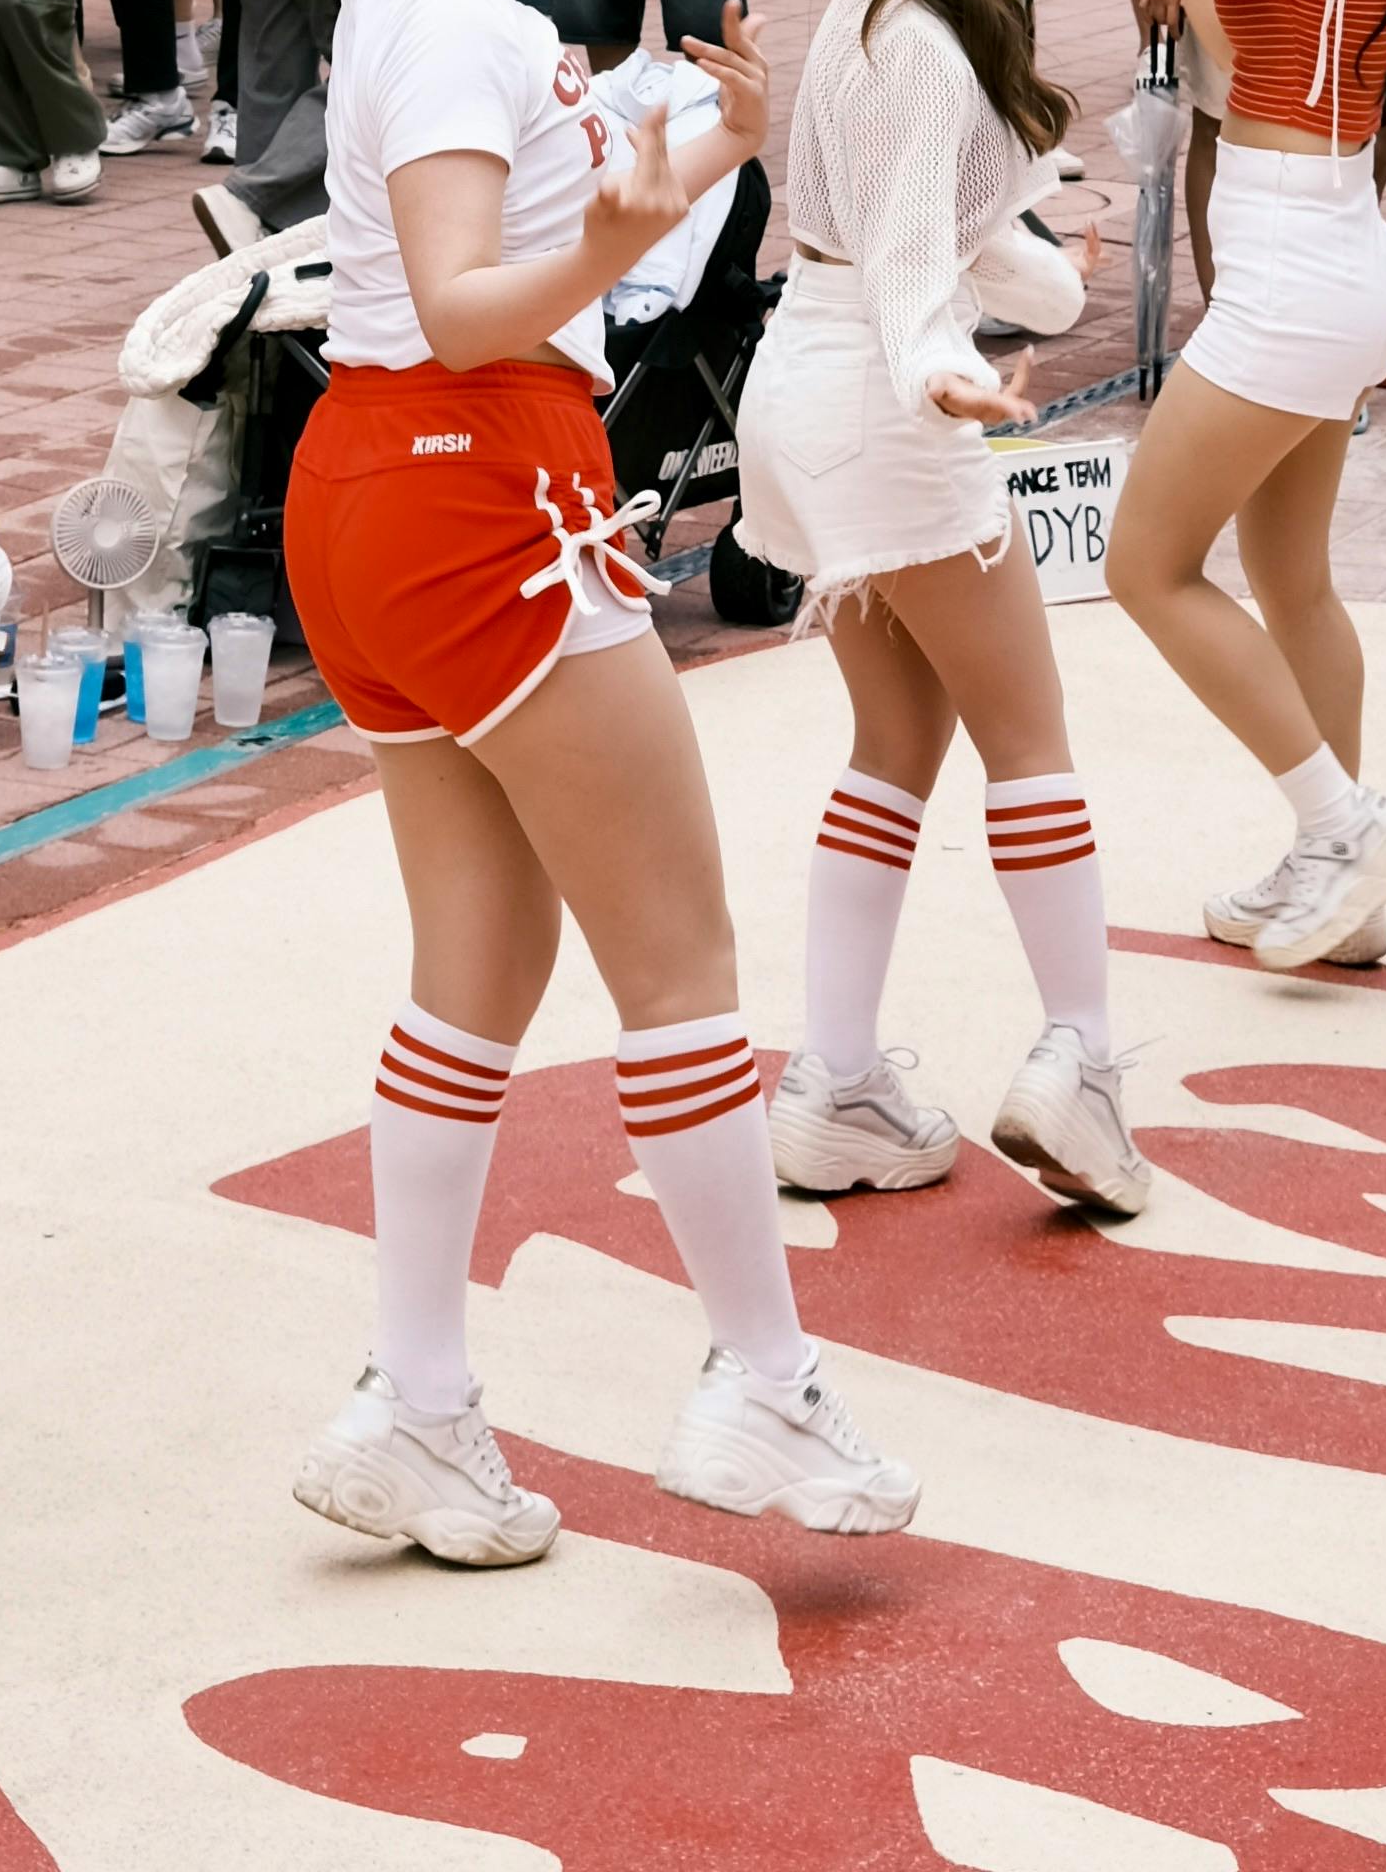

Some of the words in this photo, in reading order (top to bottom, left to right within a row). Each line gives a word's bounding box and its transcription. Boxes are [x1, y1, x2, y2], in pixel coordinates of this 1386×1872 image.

[409, 432, 472, 456] KIRSH
[1007, 462, 1058, 497] ANCE
[1063, 456, 1108, 488] TEAM
[1024, 502, 1103, 587] DYB
